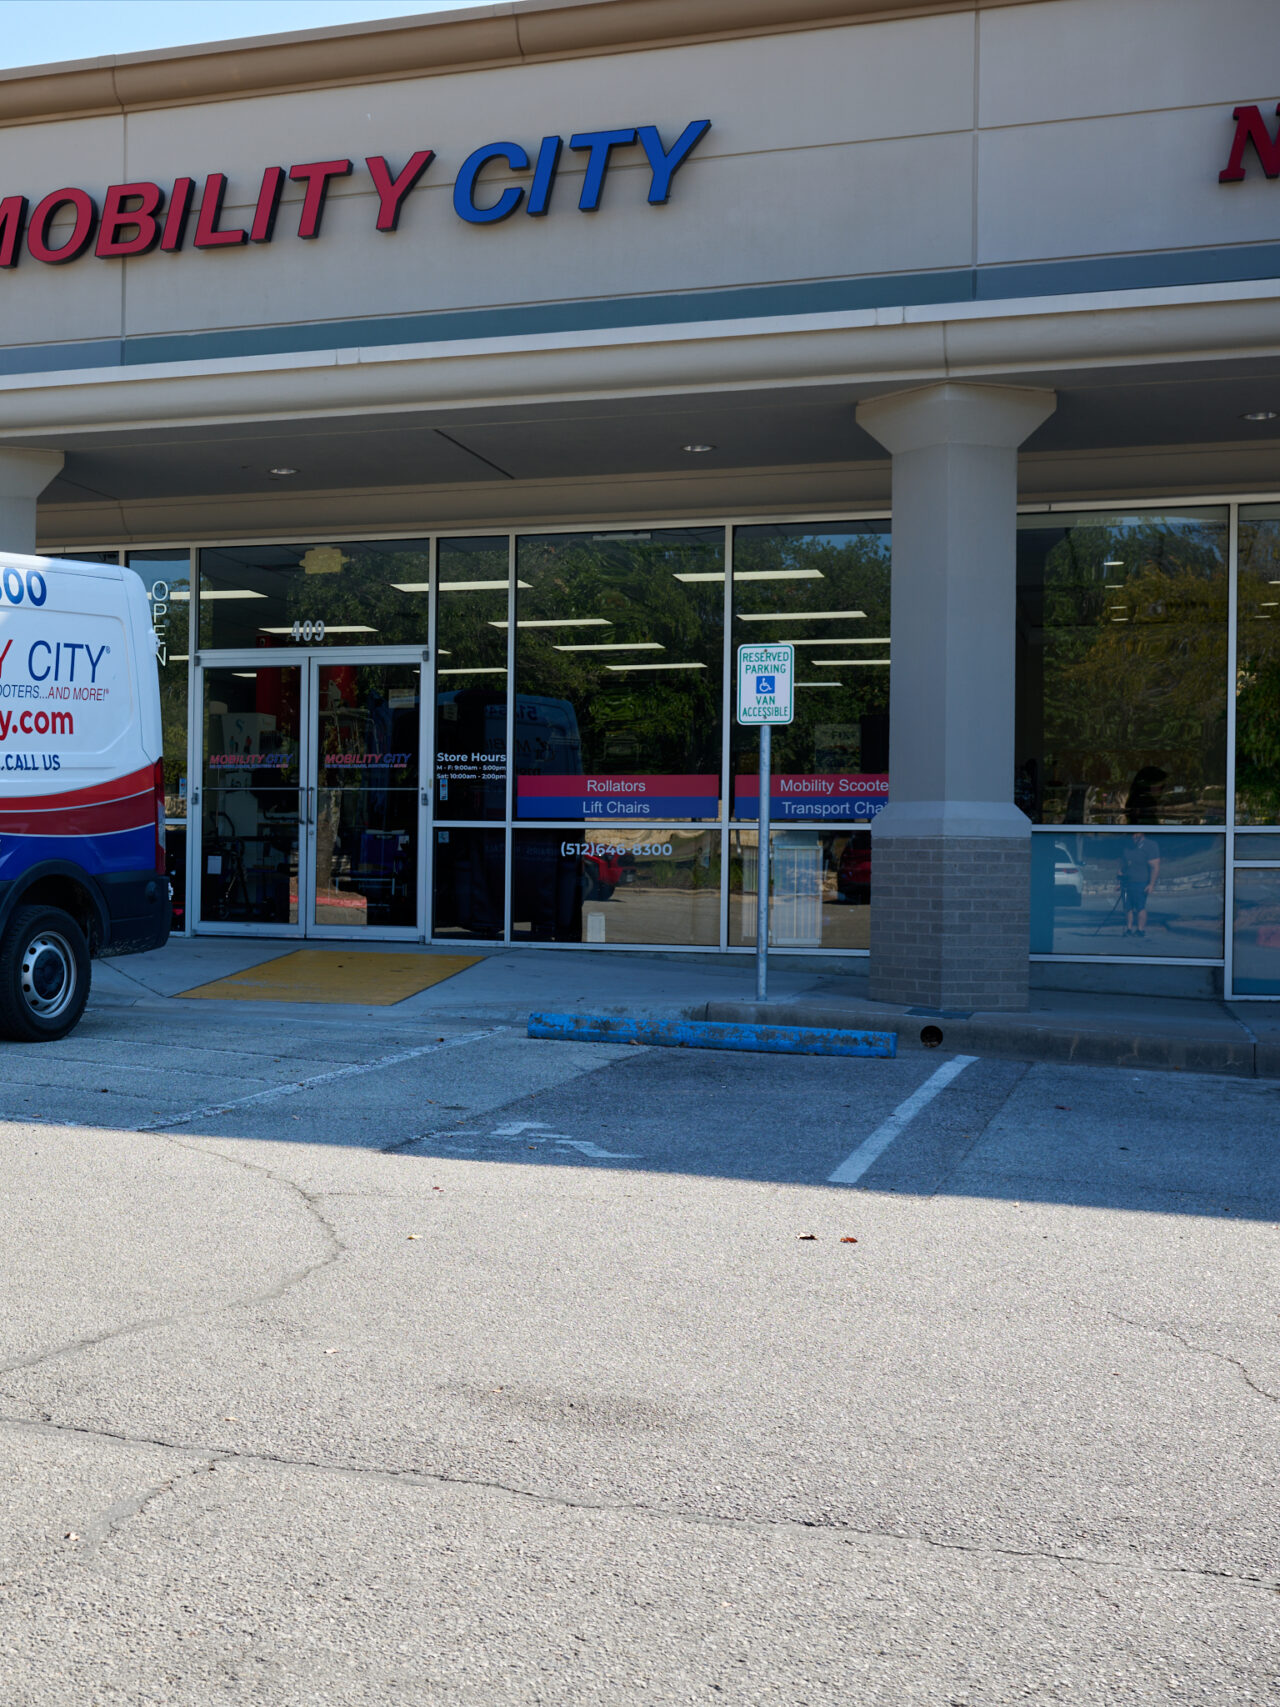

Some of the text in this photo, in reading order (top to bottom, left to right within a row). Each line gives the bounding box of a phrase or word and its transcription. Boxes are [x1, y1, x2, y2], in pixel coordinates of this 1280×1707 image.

[453, 119, 711, 226] CITY
[291, 620, 325, 641] 409
[742, 651, 789, 662] RESERVED
[745, 664, 786, 674] PARKING
[756, 696, 775, 705] VAN
[742, 706, 788, 717] ACCESSIBLE
[43, 754, 60, 770] US
[325, 753, 412, 764] MOBILITY CITY
[437, 752, 506, 761] Store Hours
[587, 779, 646, 792] Rollators
[780, 779, 835, 796] Mobility
[582, 801, 650, 814] Lift Chairs
[782, 801, 850, 818] Transport
[560, 842, 673, 858] (512)646-8300
